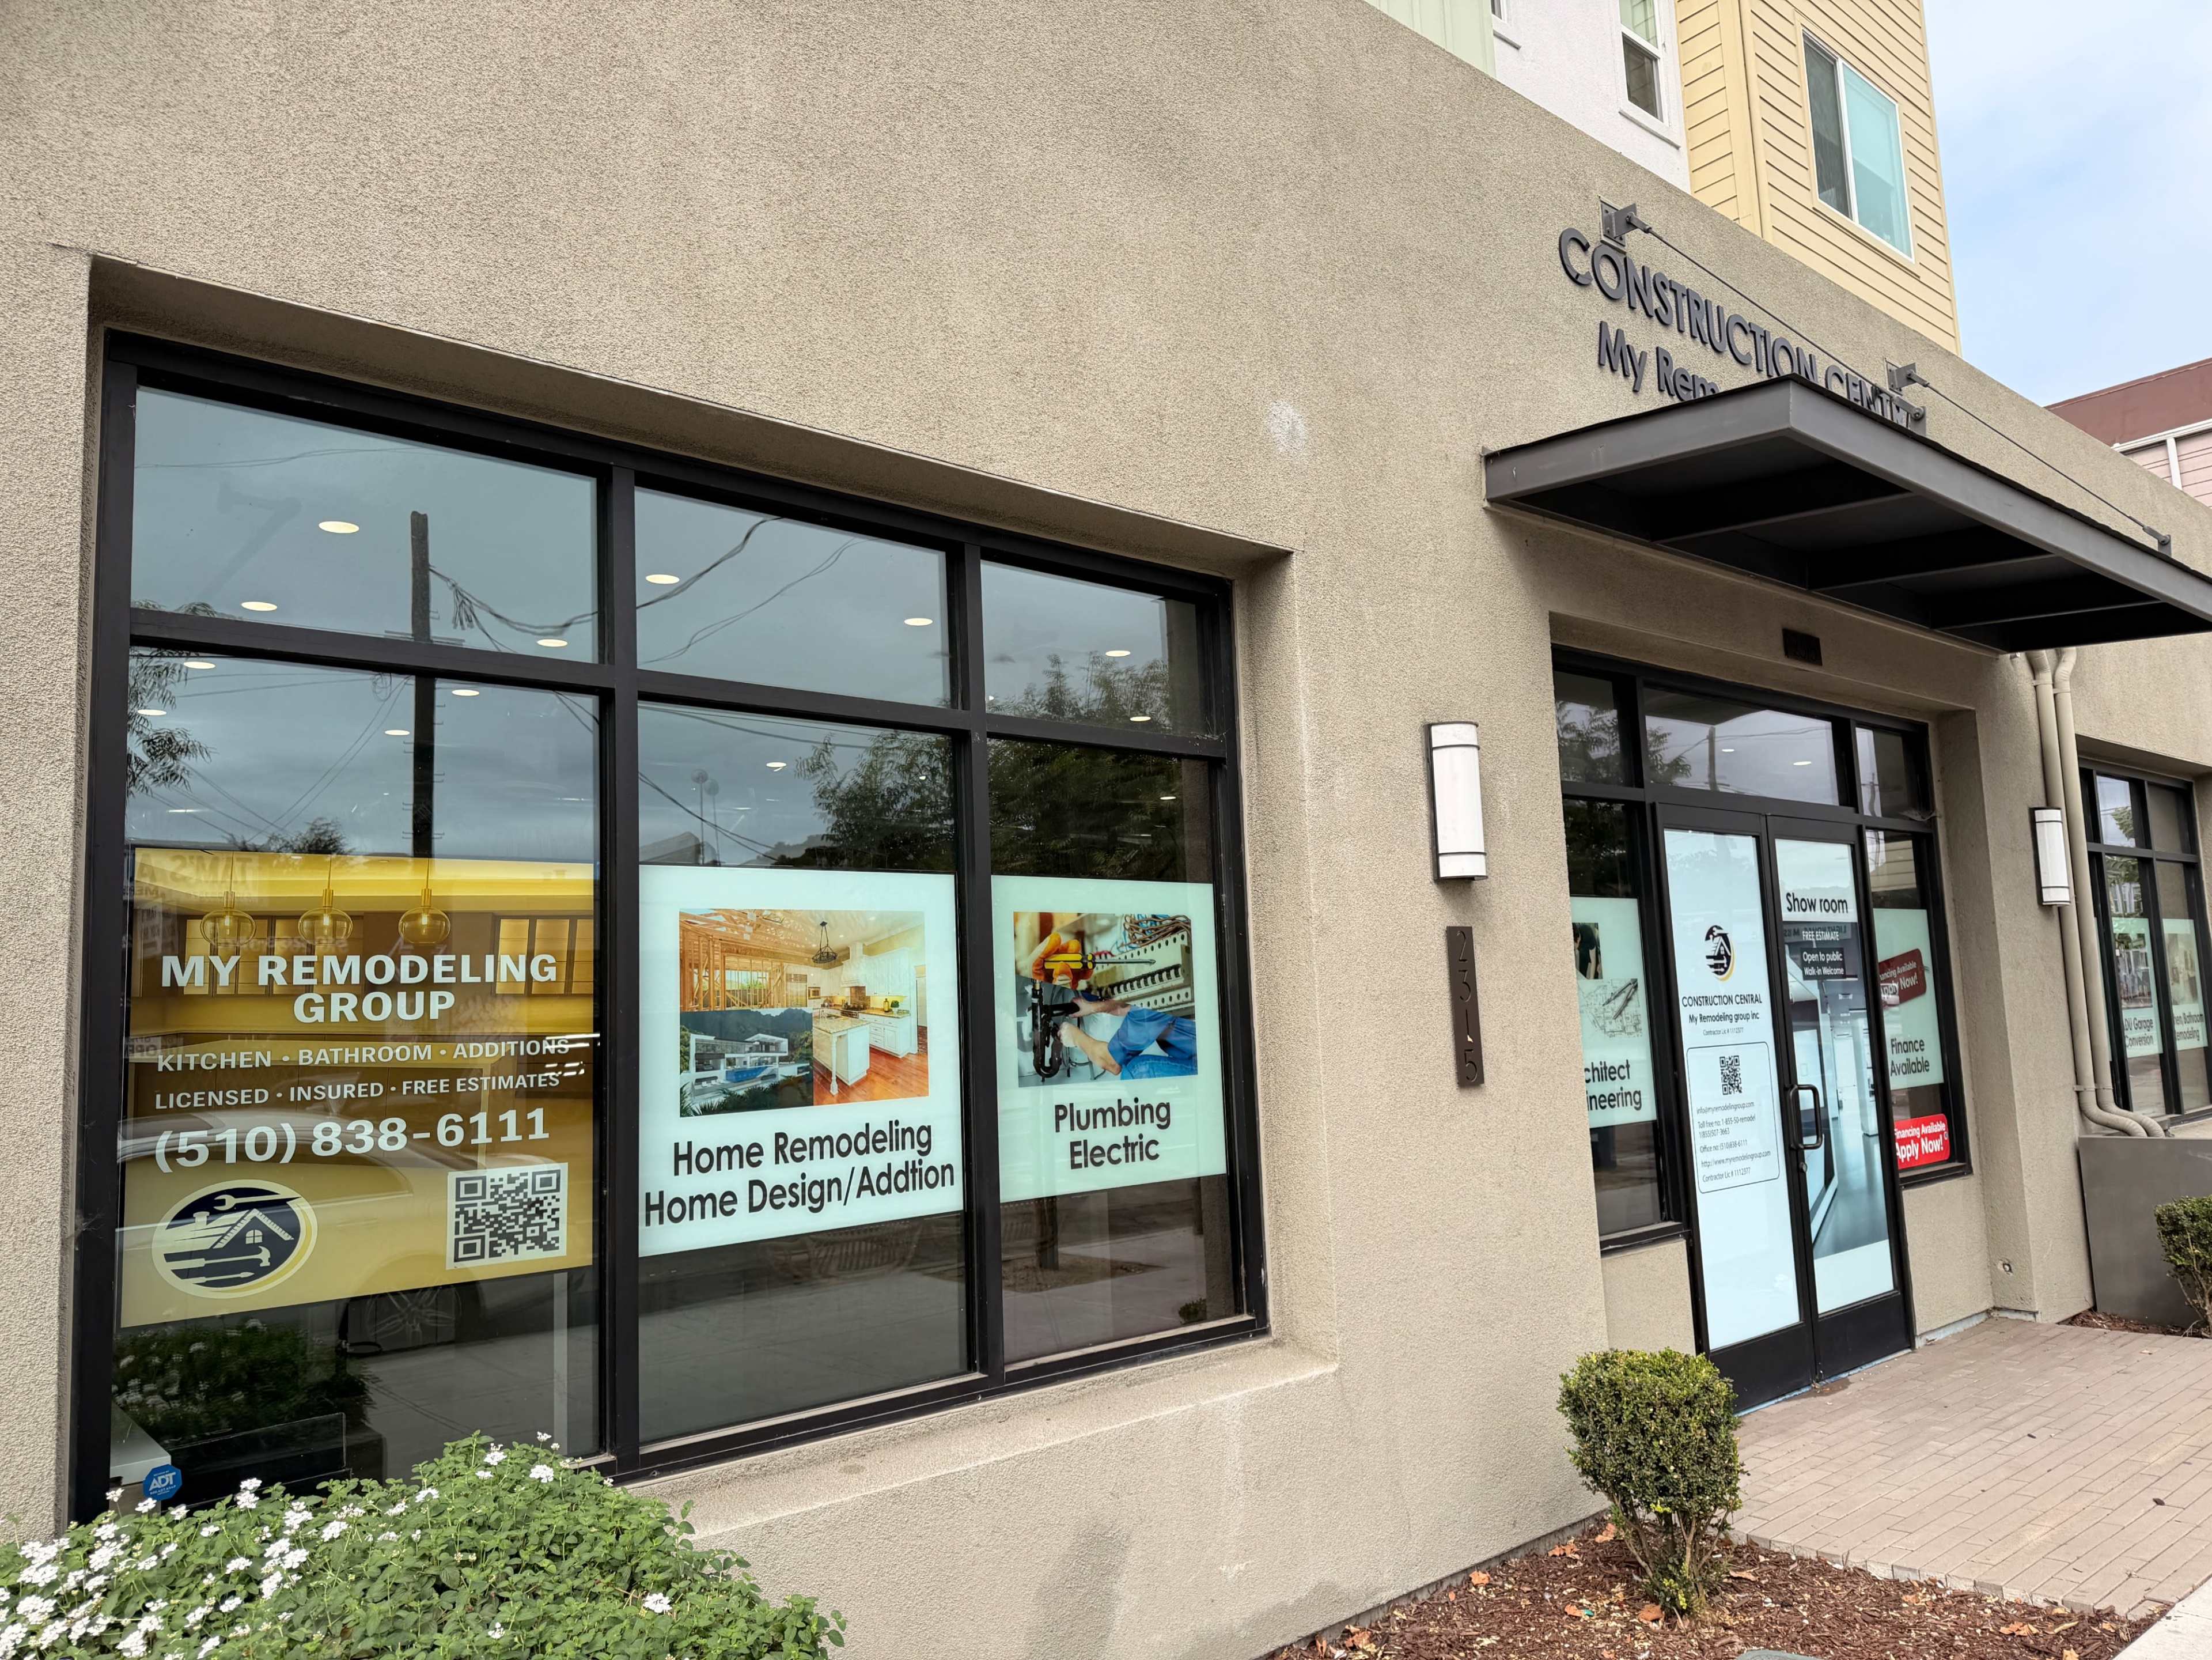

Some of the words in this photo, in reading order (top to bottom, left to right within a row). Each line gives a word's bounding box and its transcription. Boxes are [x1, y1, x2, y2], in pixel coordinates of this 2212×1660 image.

[1559, 228, 1819, 385] CONSTRUCTION
[1599, 321, 1647, 392] My
[1786, 893, 1816, 912] Show
[1820, 899, 1849, 913] room
[1802, 931, 1815, 940] FREE
[1816, 931, 1839, 941] ESTIMATE
[1803, 951, 1819, 963] Open
[1820, 952, 1825, 962] to
[1826, 951, 1843, 963] public
[162, 955, 241, 987] MY
[258, 954, 556, 986] REMODELING
[1804, 966, 1822, 975] Walk-in
[1822, 966, 1844, 975] Welcome
[1897, 961, 1917, 974] Available
[1899, 972, 1918, 990] Now!
[293, 991, 455, 1023] GROUP
[1457, 931, 1478, 1082] 2315
[1682, 995, 1733, 1007] CONSTRUCTION
[1734, 993, 1762, 1004] CENTRAL
[1689, 1014, 1698, 1025] My
[1699, 1012, 1733, 1023] Remodeling
[1734, 1013, 1750, 1023] group
[2124, 1018, 2133, 1031] DU
[2133, 1017, 2153, 1031] Garage
[157, 1051, 271, 1072] KITCHEN
[298, 1045, 432, 1066] BATHROOM
[453, 1038, 569, 1059] ADDITIONS
[1891, 1038, 1925, 1054] Finance
[1584, 1059, 1630, 1083] chitect
[1891, 1056, 1930, 1076] Available
[155, 1089, 268, 1109] LICENSED
[290, 1082, 383, 1101] INSURED
[402, 1079, 449, 1095] FREE
[456, 1073, 560, 1092] ESTIMATES
[1055, 1097, 1171, 1133] Plumbing
[1921, 1121, 1946, 1135] Available
[155, 1122, 296, 1173] (510)
[312, 1107, 550, 1157] 838-6111
[673, 1139, 764, 1177] Home
[775, 1120, 932, 1165] Remodeling
[1700, 1145, 1712, 1153] Office
[1921, 1134, 1944, 1155] Now!
[1070, 1135, 1160, 1170] Electric
[1702, 1173, 1724, 1182] Contractor
[645, 1189, 737, 1227] Home
[748, 1159, 955, 1214] Design/Addtion
[149, 1472, 176, 1491] ADT
